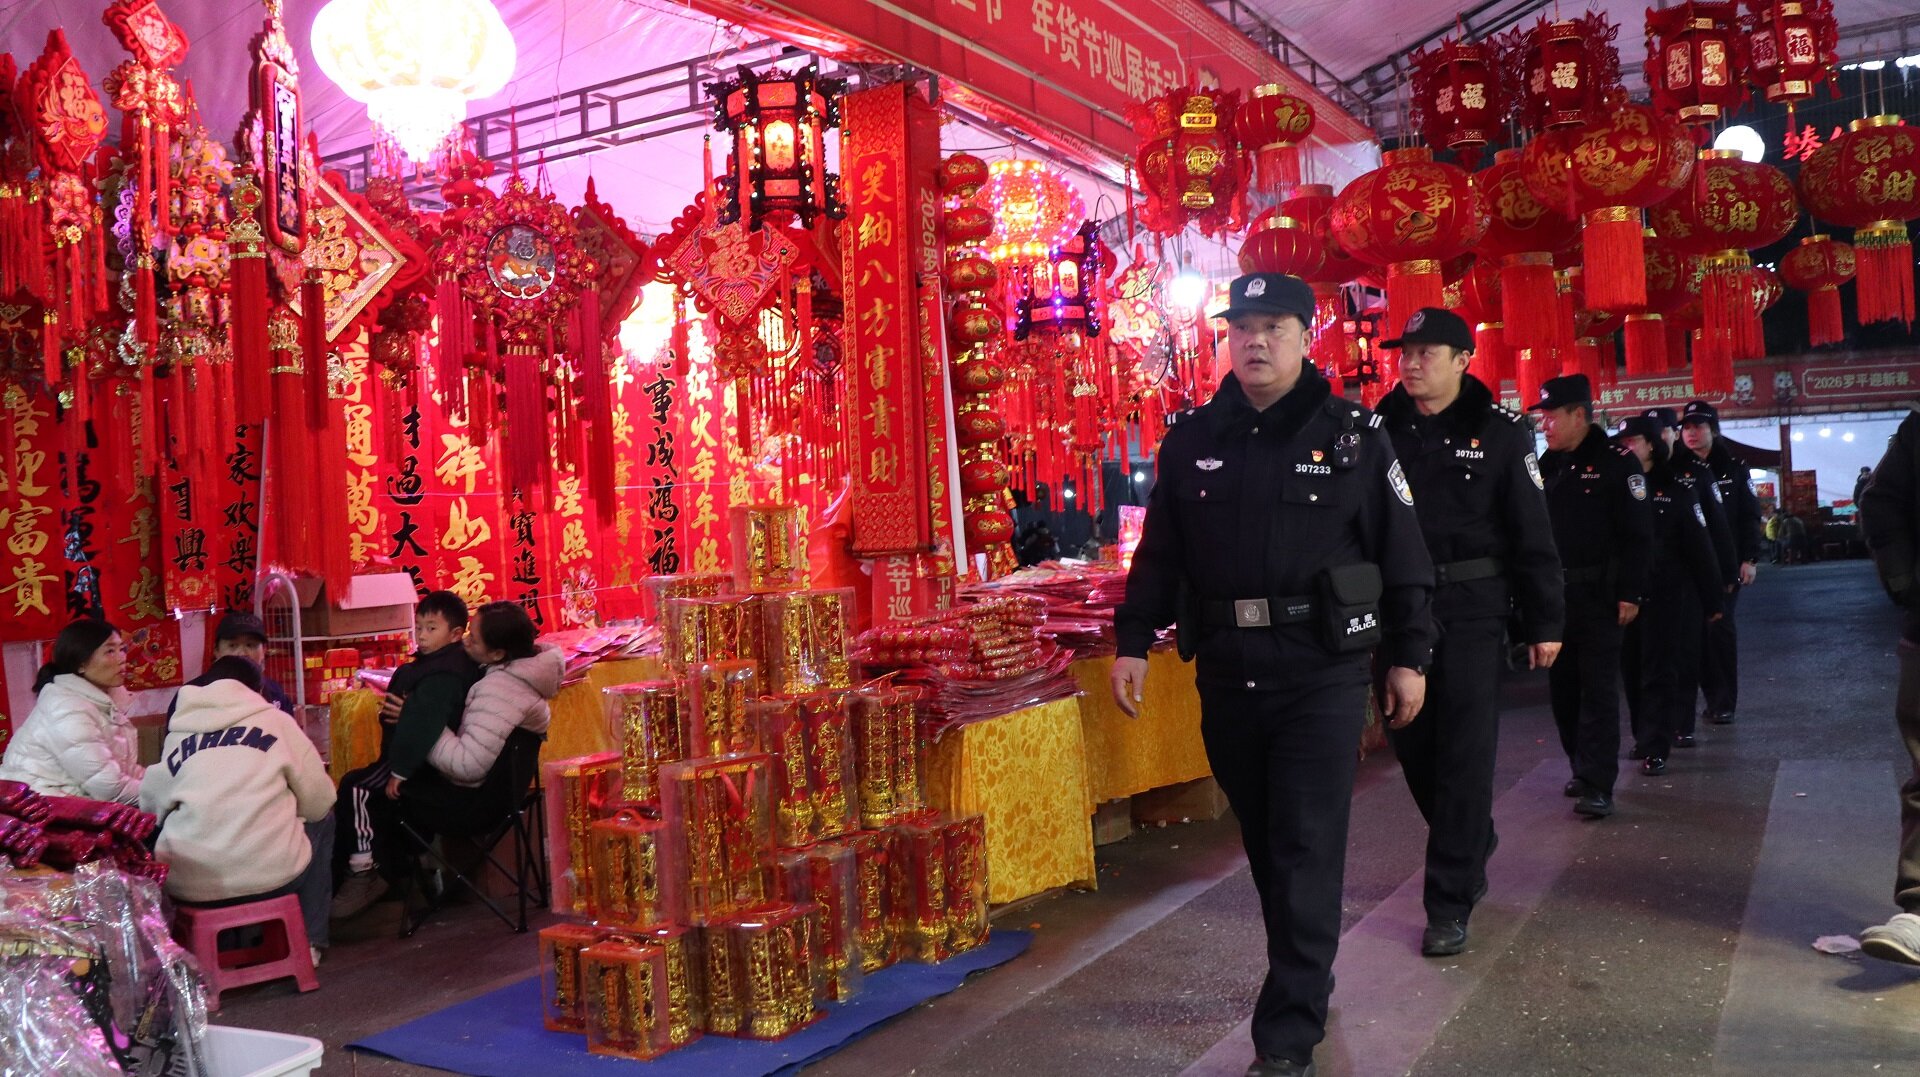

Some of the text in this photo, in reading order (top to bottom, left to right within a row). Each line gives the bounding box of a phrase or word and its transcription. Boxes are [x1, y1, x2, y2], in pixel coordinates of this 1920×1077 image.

[1031, 3, 1180, 103] 年货节巡展活动
[1752, 35, 1776, 70] 福
[1788, 33, 1815, 63] 福
[1550, 61, 1579, 89] 福
[1460, 83, 1487, 110] 福
[1273, 98, 1312, 132] 福
[857, 159, 901, 488] 笑納八方富貴財
[1635, 384, 1726, 401] 年货节巡展
[643, 350, 681, 576] 事成鴻福
[1454, 448, 1485, 460] 307124
[1294, 463, 1332, 476] 307233
[1346, 618, 1378, 636] POLICE
[1349, 612, 1374, 628] 警察
[166, 726, 279, 778] CHARM
